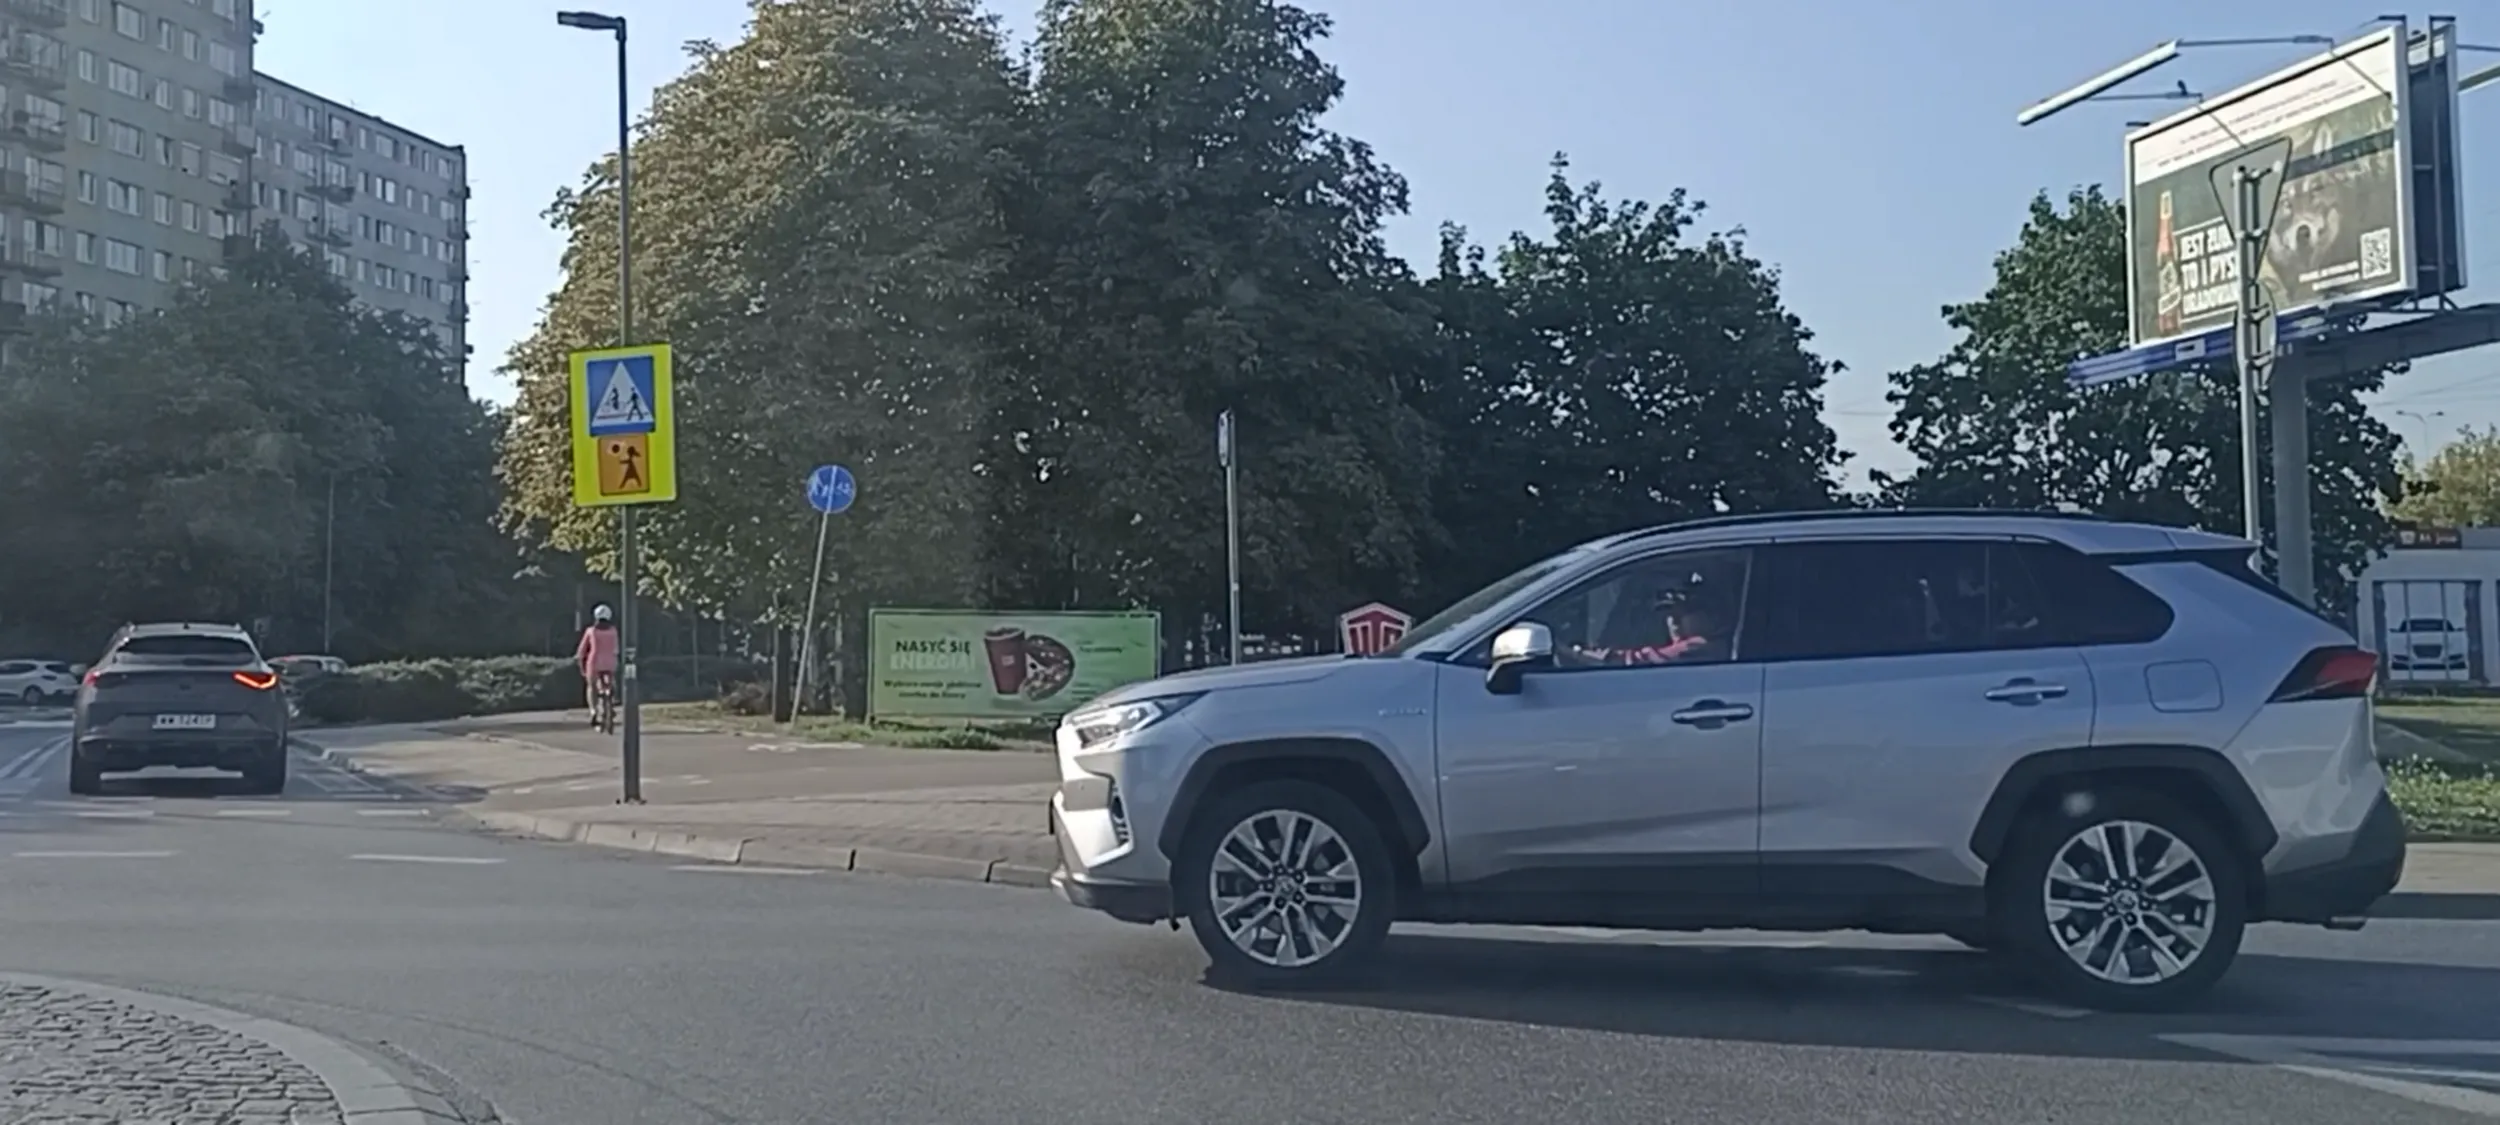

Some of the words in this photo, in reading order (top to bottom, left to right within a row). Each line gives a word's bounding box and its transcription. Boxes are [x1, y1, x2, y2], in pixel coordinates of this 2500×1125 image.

[2181, 261, 2198, 291] TO
[2209, 250, 2238, 282] PYS
[895, 639, 946, 653] NASYĆ
[949, 640, 971, 656] SIĘ
